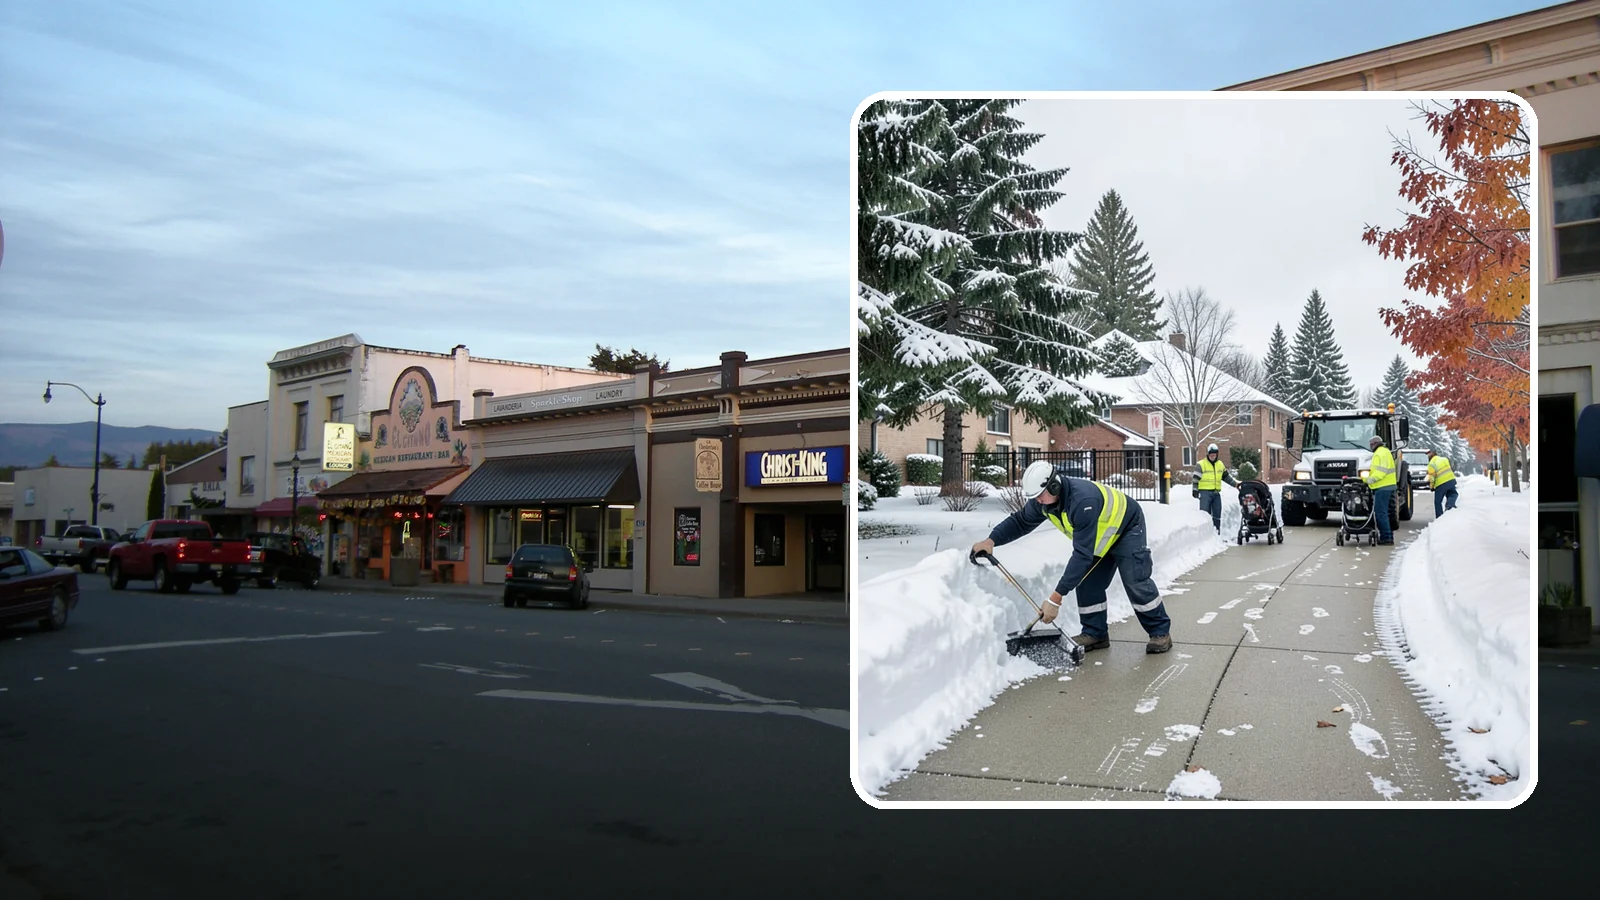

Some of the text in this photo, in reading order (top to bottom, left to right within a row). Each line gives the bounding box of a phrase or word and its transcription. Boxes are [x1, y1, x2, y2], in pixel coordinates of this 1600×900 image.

[531, 394, 582, 408] Sparkle Shop
[595, 389, 623, 400] LAUNDRY
[493, 402, 522, 413] LAVANDERIA
[373, 455, 396, 464] MEXICAN
[397, 452, 433, 462] RESTAURANT
[438, 450, 450, 459] BAR
[760, 452, 797, 478] CHRIST
[799, 450, 827, 476] KING
